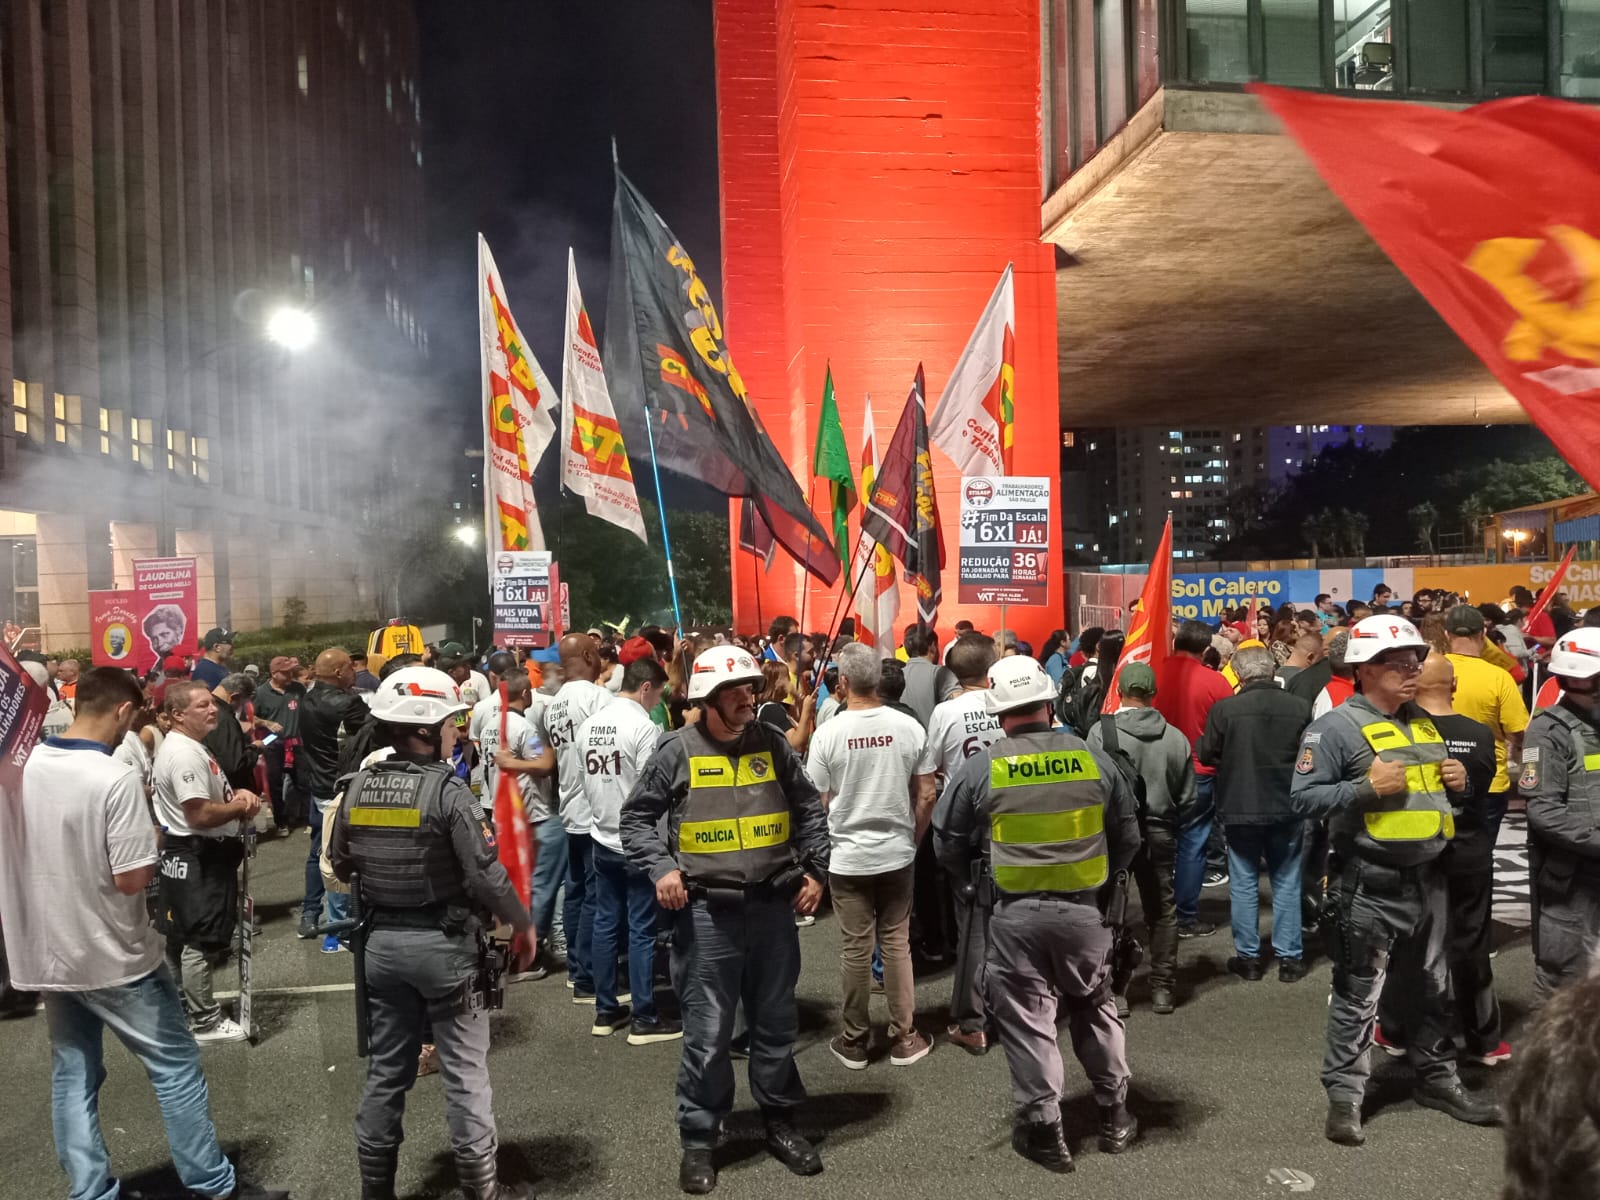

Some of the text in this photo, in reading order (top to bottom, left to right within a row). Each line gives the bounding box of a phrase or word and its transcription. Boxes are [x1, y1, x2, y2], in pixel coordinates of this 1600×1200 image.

[1000, 512, 1013, 521] Da
[1015, 512, 1047, 522] Escala
[980, 521, 1042, 543] 6x1 JÁ!
[961, 555, 1010, 568] REDUÇÃO
[1014, 552, 1036, 568] 36
[138, 570, 191, 582] LAUDELINA
[1530, 563, 1600, 584] So Cal
[528, 578, 548, 586] Escala
[1171, 576, 1281, 598] Sol Calero
[505, 586, 545, 602] 6x1 JÁ!
[496, 608, 538, 617] MAIS VIDA
[1171, 604, 1198, 619] no
[1389, 625, 1399, 639] P
[726, 657, 735, 672] P
[1009, 675, 1032, 685] POLÍCIA
[0, 682, 26, 746] ALHADORES
[964, 710, 986, 722] FIM
[590, 726, 617, 735] FIM DA
[589, 737, 615, 747] ESCALA
[847, 735, 893, 750] FITIASP
[585, 749, 622, 776] 6x1
[1008, 754, 1084, 779] POLÍCIA
[363, 774, 415, 790] POLÍCIA
[359, 791, 412, 804] MILITAR
[695, 822, 783, 844] POLÍCIA MILITAR
